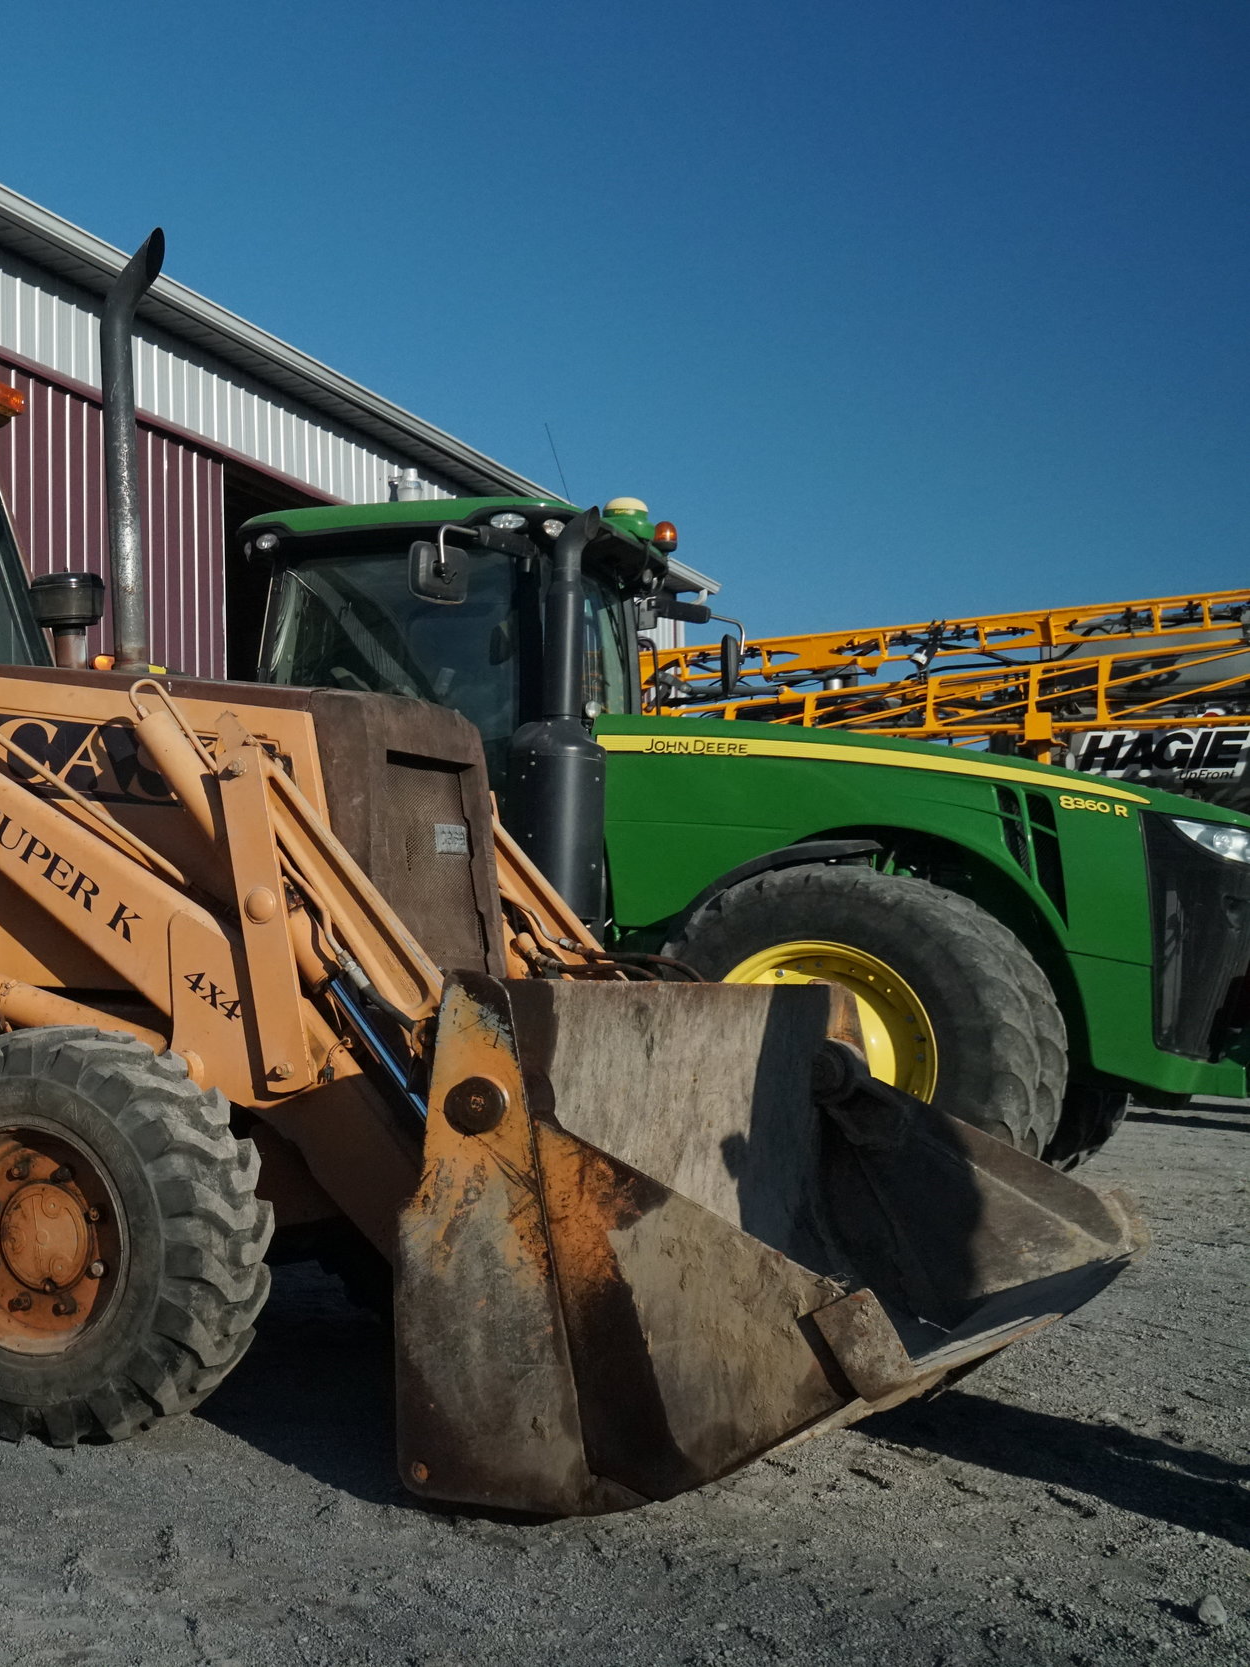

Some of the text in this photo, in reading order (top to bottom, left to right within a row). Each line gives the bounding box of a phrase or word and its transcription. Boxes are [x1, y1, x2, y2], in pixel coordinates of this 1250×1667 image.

[645, 738, 748, 754] JOHN DEERE
[1078, 729, 1250, 772] HAGIE
[1058, 795, 1130, 818] 8360 R
[106, 901, 142, 943] K
